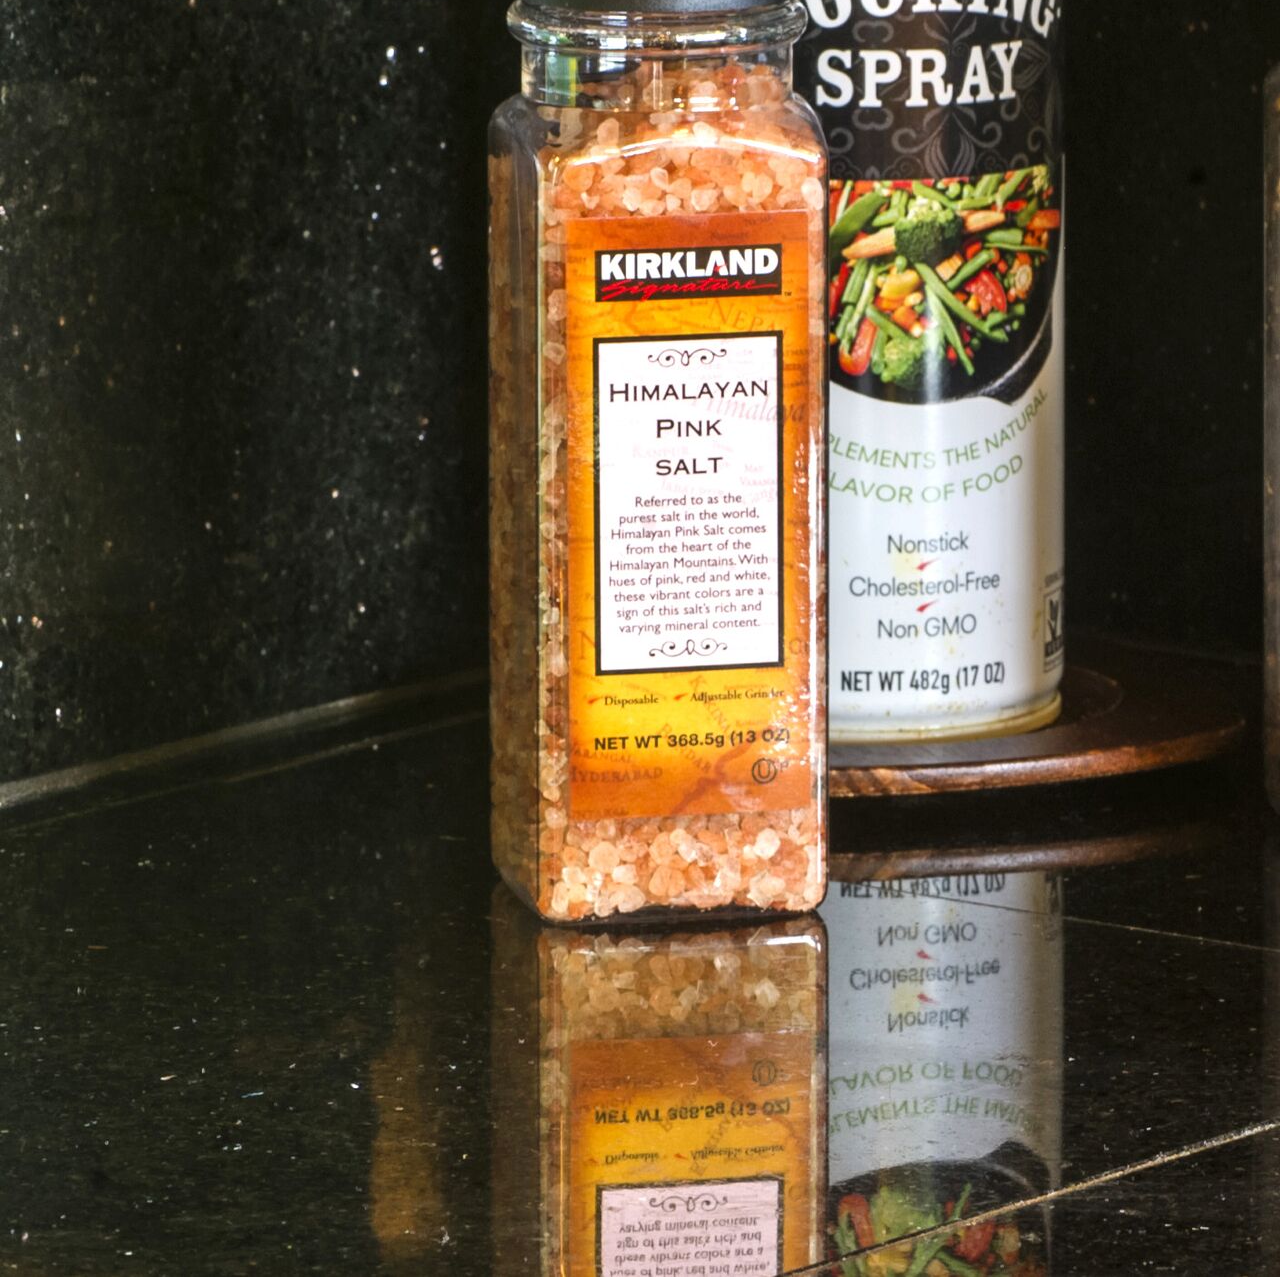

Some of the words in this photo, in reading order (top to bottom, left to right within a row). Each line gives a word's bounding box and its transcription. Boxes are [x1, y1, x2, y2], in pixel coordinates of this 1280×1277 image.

[816, 40, 1022, 108] SPRAY
[601, 248, 779, 280] KIRKLAND
[601, 277, 778, 302] Signature
[609, 380, 768, 403] HIMALAYAN
[656, 419, 722, 438] PINK
[829, 433, 937, 470] LEMENTS
[943, 440, 981, 466] THE
[984, 388, 1048, 454] NATURAL
[655, 457, 723, 476] SALT
[829, 472, 913, 504] LAVOR
[921, 483, 955, 503] OF
[962, 455, 1023, 497] FOOD
[635, 495, 686, 508] Referred
[691, 496, 703, 506] to
[707, 496, 719, 505] as
[723, 493, 742, 504] the
[619, 512, 657, 526] purest
[661, 511, 680, 522] salt
[684, 511, 695, 521] in
[699, 510, 718, 520] the
[611, 528, 671, 541] Himalayan
[675, 526, 700, 537] Pink
[704, 524, 724, 536] Salt
[729, 525, 767, 535] comes
[887, 530, 969, 554] Nonstick
[626, 544, 654, 555] from
[659, 543, 678, 553] the
[682, 542, 713, 552] heart
[717, 540, 729, 551] of
[732, 539, 751, 550] the
[610, 560, 669, 572] Himalayan
[738, 554, 768, 565] With
[609, 576, 636, 587] hues
[640, 574, 652, 585] of
[686, 572, 706, 583] red
[709, 571, 730, 582] and
[849, 571, 1000, 597] Cholesterol-Free
[614, 592, 645, 602] these
[650, 590, 690, 601] vibrant
[694, 588, 731, 599] colors
[735, 588, 754, 597] are
[758, 588, 764, 596] a
[617, 608, 638, 620] sign
[643, 606, 655, 617] of
[659, 605, 679, 616] this
[715, 602, 737, 613] rich
[741, 601, 762, 611] and
[619, 622, 661, 635] varying
[665, 619, 708, 631] mineral
[877, 619, 918, 639] Non
[924, 614, 977, 637] GMO
[841, 671, 873, 691] NET
[879, 671, 904, 691] WT
[910, 670, 950, 694] 482g
[956, 665, 979, 688] (17
[984, 661, 1005, 684] OZ)
[604, 695, 659, 706] Disposable
[690, 691, 742, 704] Adjustable
[595, 737, 628, 751] NET
[634, 735, 662, 748] WT
[667, 733, 725, 749] 368.5g
[730, 730, 757, 747] (13
[762, 729, 790, 744] OZ)
